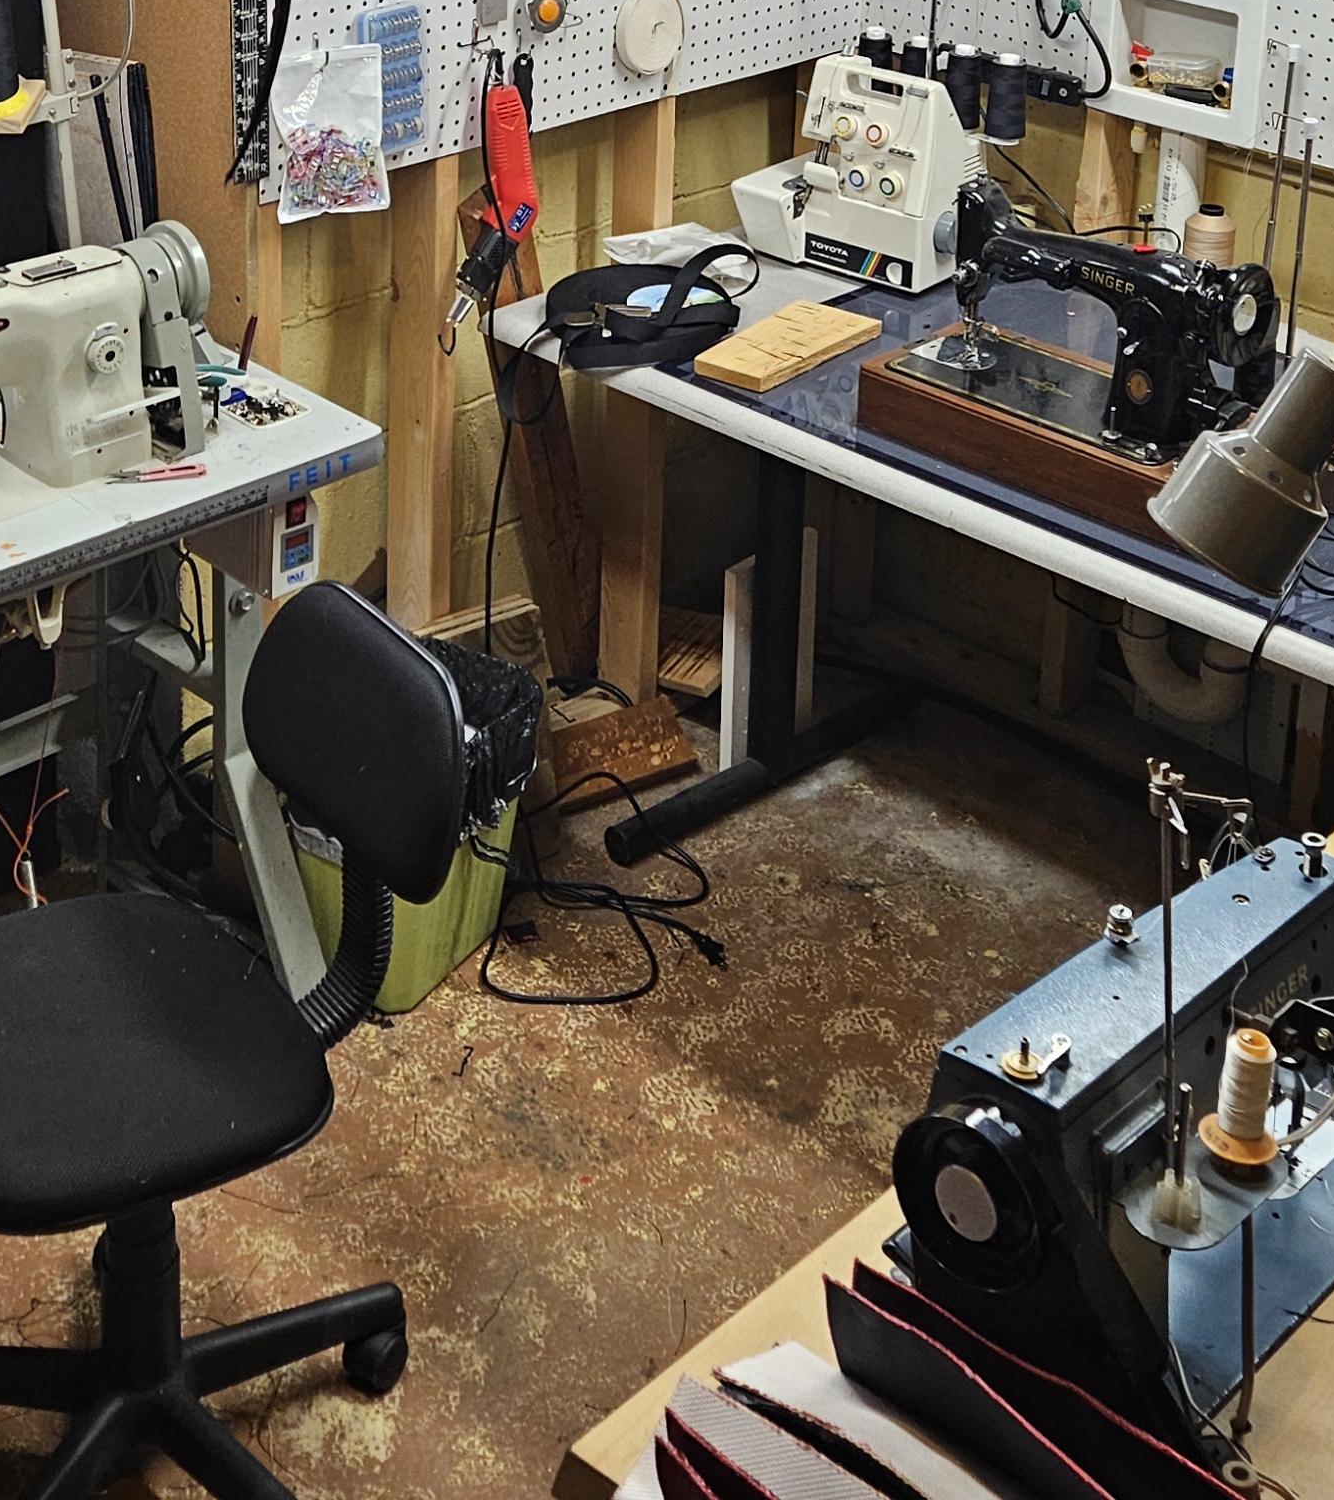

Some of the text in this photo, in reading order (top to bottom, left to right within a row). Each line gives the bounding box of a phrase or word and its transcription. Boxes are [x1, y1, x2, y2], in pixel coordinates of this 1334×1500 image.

[809, 239, 849, 257] TOYOTA
[1081, 265, 1135, 296] SINGER
[288, 453, 352, 492] FEIT
